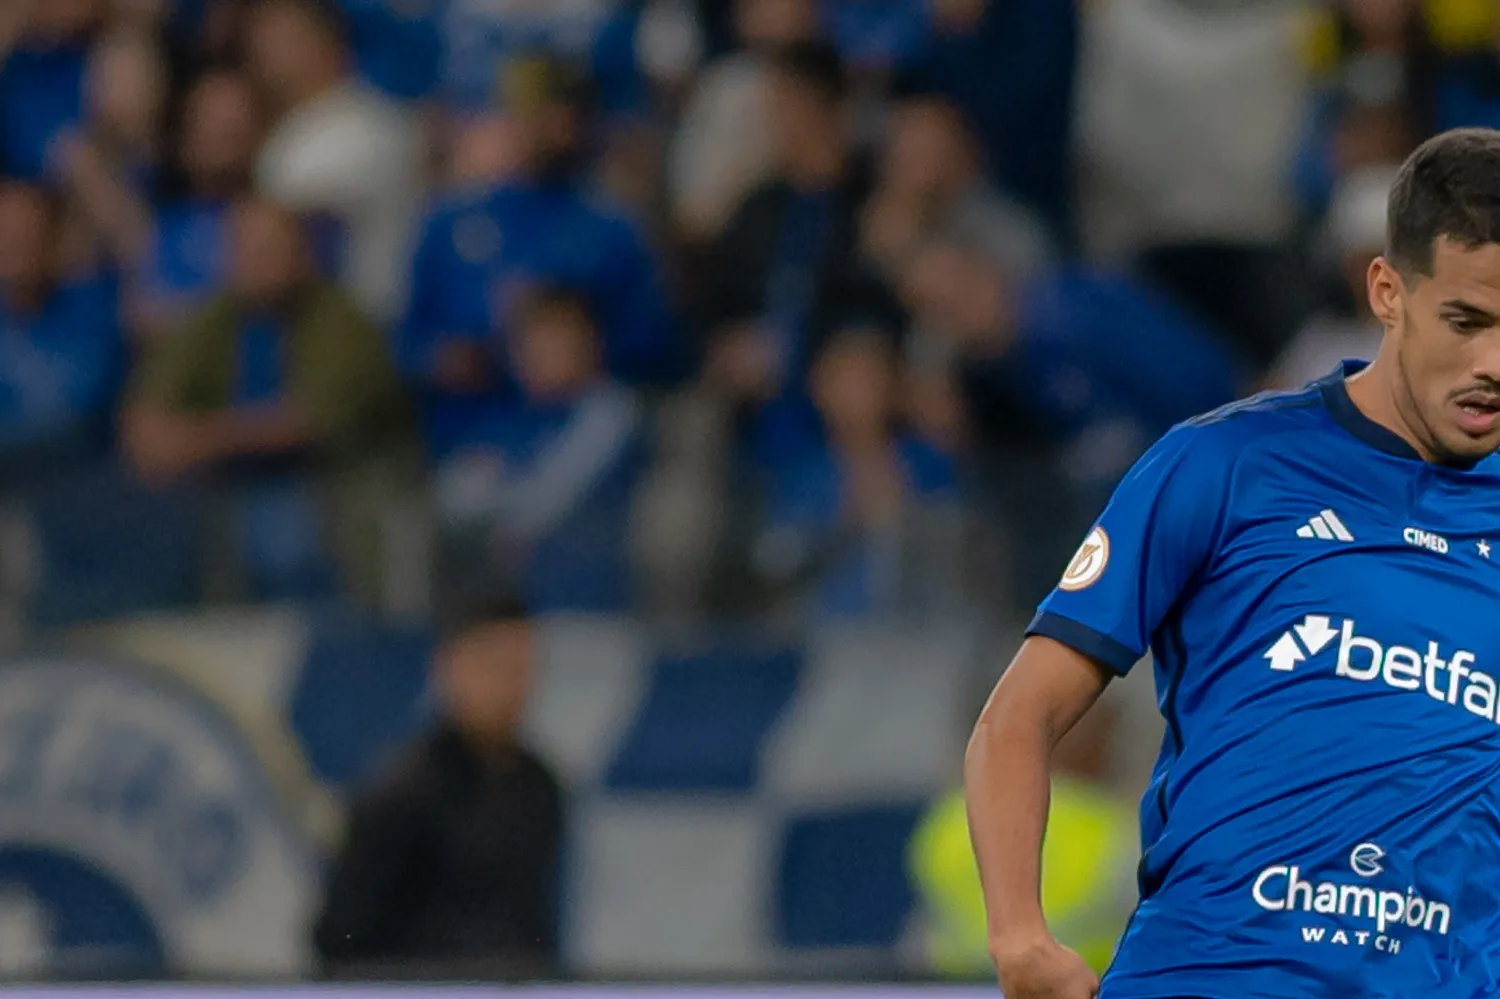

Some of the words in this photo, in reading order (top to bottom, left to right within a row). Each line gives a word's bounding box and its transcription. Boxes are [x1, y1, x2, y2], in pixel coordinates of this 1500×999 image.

[1403, 527, 1449, 554] CIMED
[1252, 863, 1450, 935] Champion
[1301, 927, 1401, 955] WATCH
